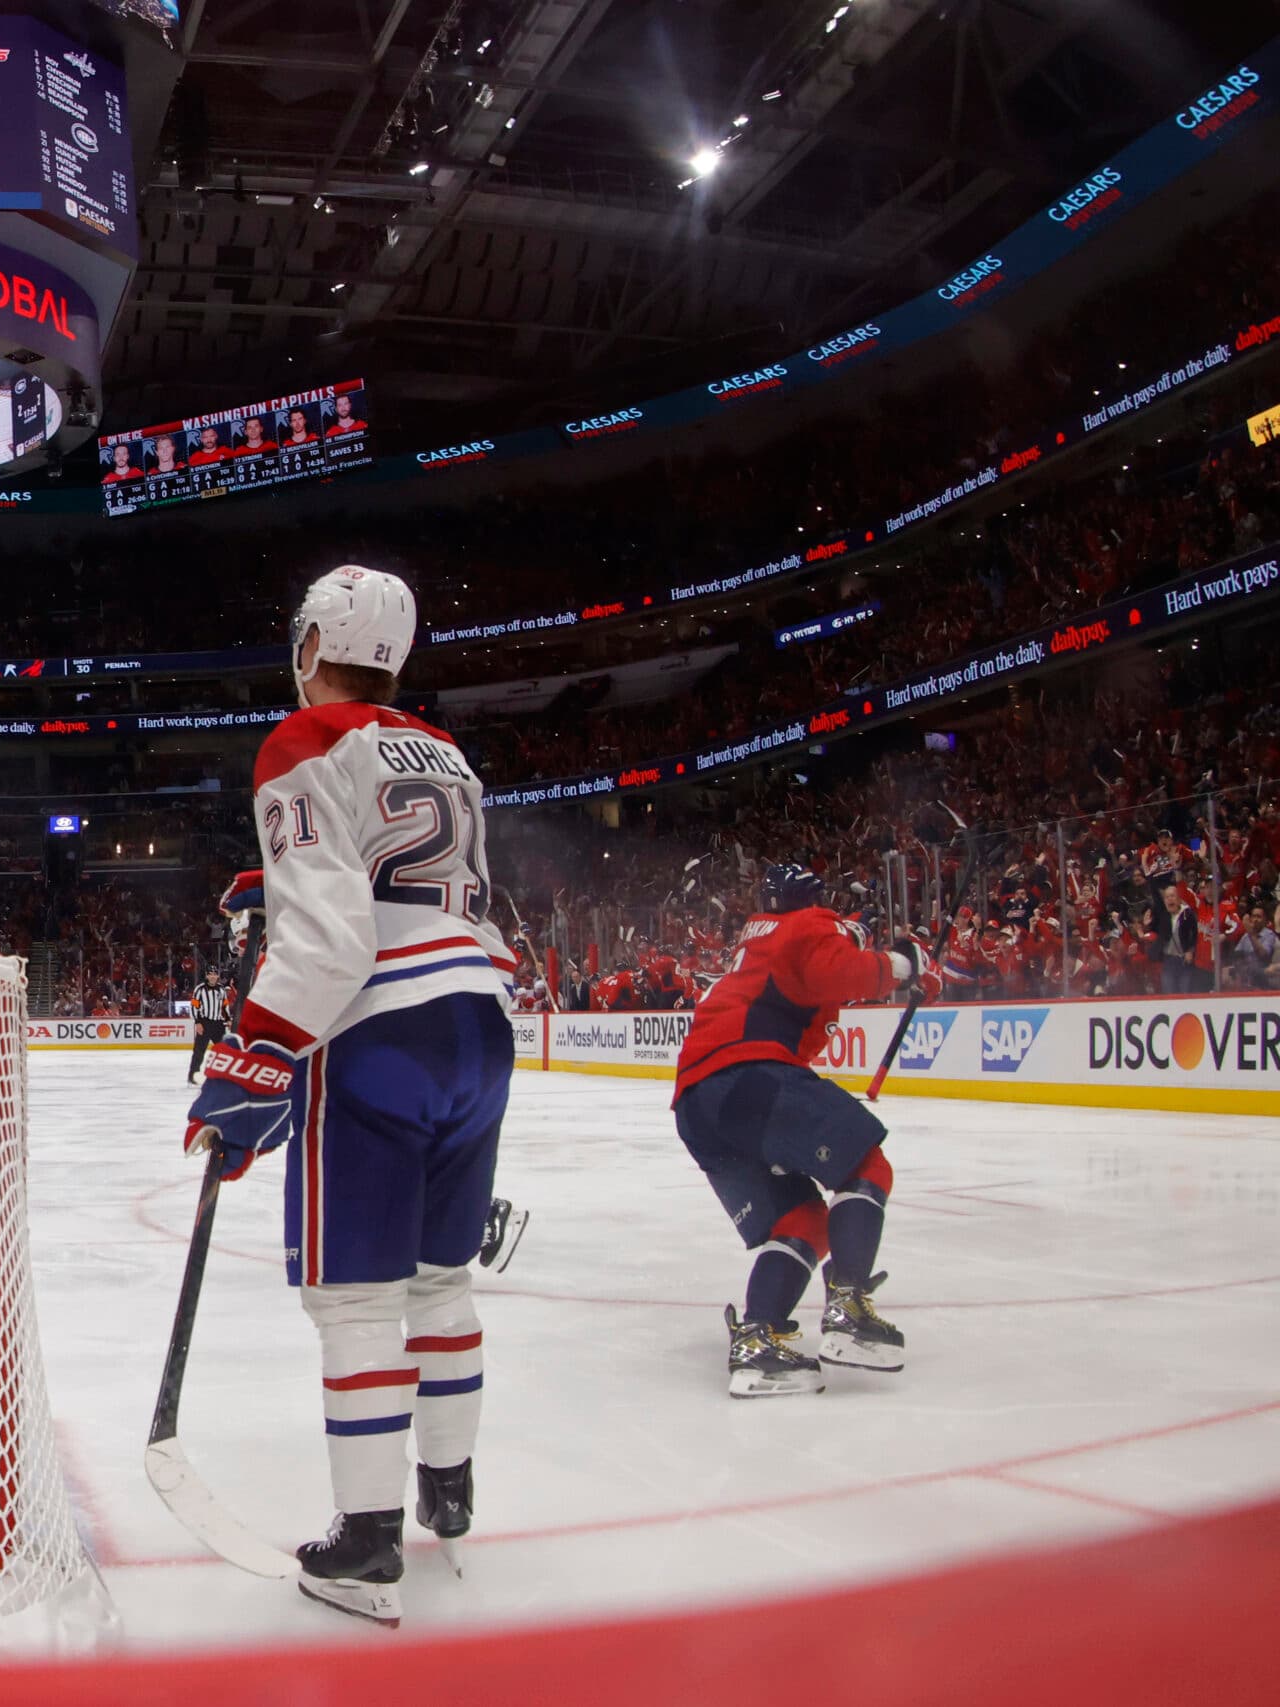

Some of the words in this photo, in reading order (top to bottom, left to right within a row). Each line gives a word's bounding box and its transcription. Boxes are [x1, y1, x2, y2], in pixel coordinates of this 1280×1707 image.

[1176, 66, 1260, 129] CAESARS
[1047, 166, 1122, 222] CAESARS
[79, 204, 115, 232] CAESARS
[937, 254, 1003, 300] CAESARS
[807, 323, 881, 361] CAESARS
[707, 363, 788, 396] CAESARS
[1082, 404, 1108, 432] Hard
[1107, 395, 1134, 418] work
[1133, 384, 1156, 410] pays
[1157, 372, 1170, 393] off
[1172, 369, 1187, 385] on
[1186, 359, 1204, 378] the
[108, 435, 118, 446] ON
[118, 432, 131, 443] THE
[132, 430, 144, 441] ICE
[182, 401, 267, 431] WASHINGTON
[271, 386, 336, 411] CAPITALS
[565, 407, 643, 434] CAESARS
[329, 446, 352, 458] SAVES
[353, 443, 365, 453] 33
[416, 439, 495, 464] CAESARS
[1165, 582, 1203, 615] Hard
[1202, 569, 1243, 600] work
[1242, 560, 1278, 593] pays
[431, 629, 455, 643] Hard
[456, 625, 482, 638] work
[483, 624, 505, 636] pays
[507, 619, 520, 631] off
[522, 619, 535, 630] on
[537, 615, 553, 628] the
[76, 665, 89, 673] 30
[374, 642, 391, 663] 21
[886, 687, 911, 709] Hard
[911, 675, 938, 698] work
[938, 670, 962, 695] pays
[964, 660, 978, 681] off
[980, 660, 994, 676] on
[996, 652, 1014, 671] the
[378, 740, 470, 780] GUHLE
[265, 794, 318, 863] 21
[369, 780, 491, 924] 21
[57, 1023, 142, 1040] DISCOVER
[149, 1025, 186, 1038] ESPN
[566, 1024, 627, 1049] MassMutual
[633, 1017, 694, 1047] BODYAR
[899, 1019, 944, 1060] SAP
[982, 1020, 1033, 1061] SAP
[1088, 1012, 1280, 1070] DISCOVER
[634, 1050, 652, 1059] SPORTS
[653, 1051, 669, 1060] DRINK
